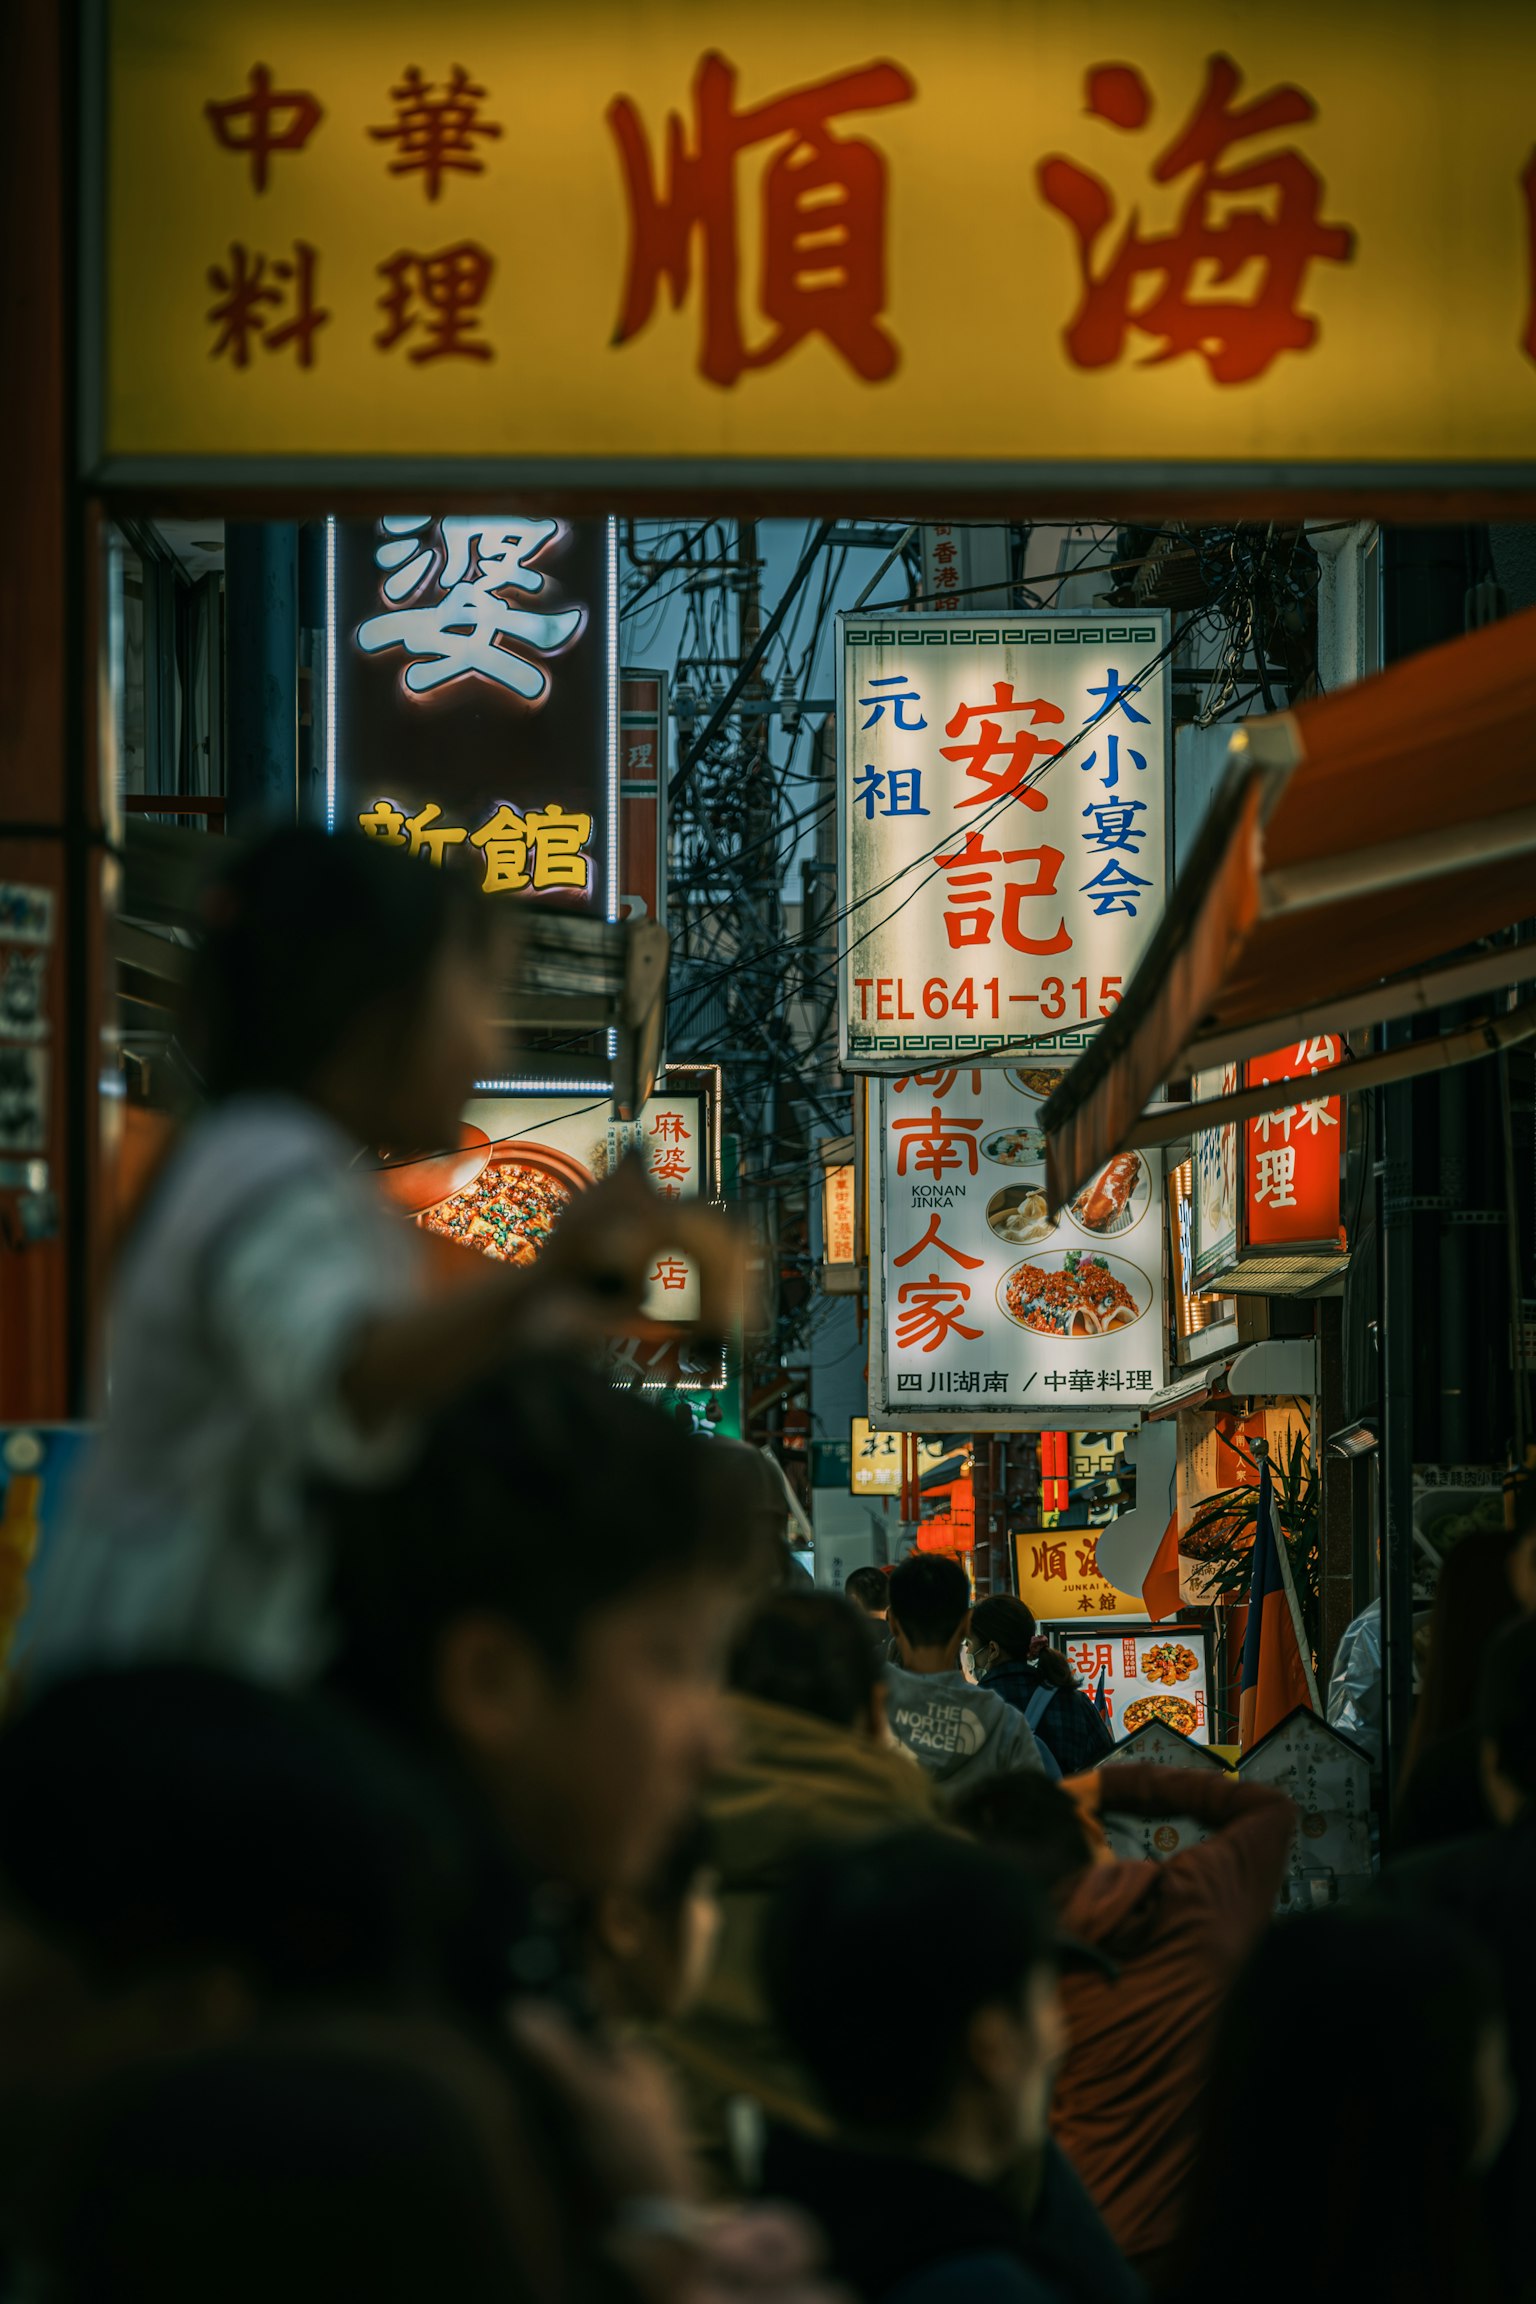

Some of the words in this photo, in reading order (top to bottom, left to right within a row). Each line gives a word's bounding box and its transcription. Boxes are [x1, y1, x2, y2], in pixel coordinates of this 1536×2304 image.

[203, 62, 502, 202] 中華
[605, 46, 1536, 390] 順海
[205, 240, 497, 370] 料理
[852, 675, 931, 821] 元祖
[1078, 667, 1153, 918] 大小宴会
[933, 681, 1073, 956] 安記
[854, 978, 915, 1021] TEL
[911, 1185, 966, 1197] KONAN
[911, 1196, 954, 1208] JINKA
[897, 1370, 1010, 1393] 四川湖南
[1043, 1369, 1154, 1393] 中華料理
[1063, 1583, 1100, 1592] JUNKAI
[1077, 1593, 1117, 1612] 本館
[895, 1709, 959, 1738] NORTH
[927, 1702, 961, 1721] THE
[910, 1728, 956, 1753] FACE
